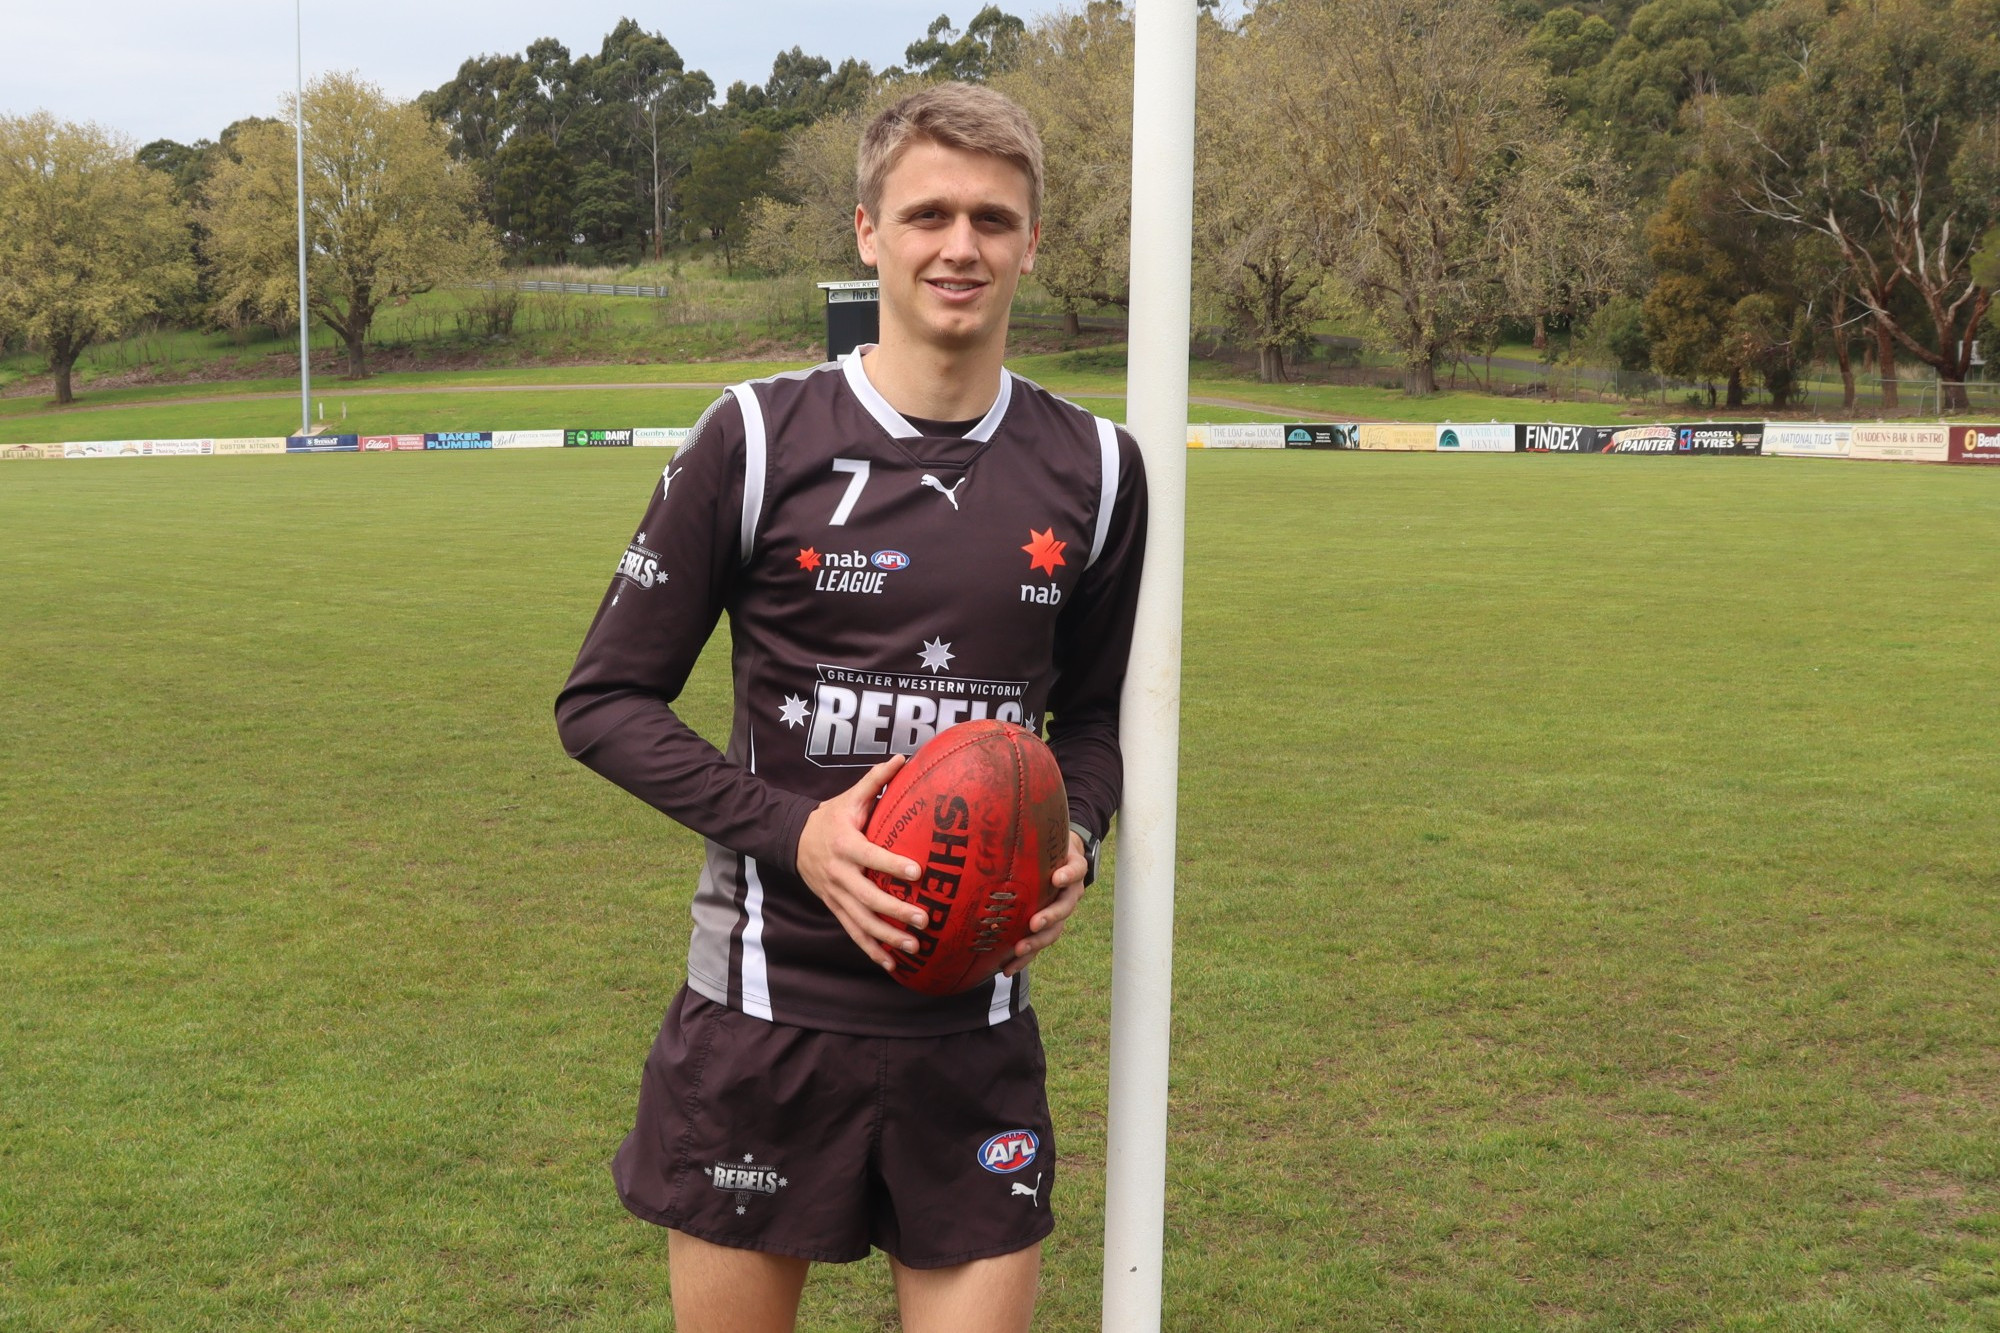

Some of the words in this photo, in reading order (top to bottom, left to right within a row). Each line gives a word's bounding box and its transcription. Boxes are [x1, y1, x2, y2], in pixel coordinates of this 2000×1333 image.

[852, 291, 867, 300] Five
[870, 290, 879, 300] St
[437, 432, 480, 441] BAKER
[634, 429, 666, 438] Country
[668, 428, 688, 437] Road
[1213, 428, 1227, 438] THE
[1256, 428, 1283, 438] LOUNGE
[1460, 427, 1492, 438] COUNTRY
[1525, 425, 1583, 451] FINDEX
[1694, 430, 1733, 438] COASTAL
[1780, 432, 1812, 445] NATIONAL
[1814, 433, 1833, 445] TILES
[1892, 432, 1908, 443] BAR
[1917, 433, 1944, 444] BISTRO
[365, 439, 390, 449] Elders
[426, 440, 492, 449] PLUMBING
[1471, 440, 1501, 450] DENTAL
[1621, 439, 1675, 452] PAINTER
[1692, 438, 1735, 448] TYRES
[828, 457, 871, 526] 7
[825, 550, 867, 568] nab
[875, 554, 906, 566] AFL
[815, 569, 888, 594] LEAGUE
[1020, 582, 1062, 606] nab
[827, 670, 892, 687] GREATER
[898, 677, 965, 694] WESTERN
[969, 683, 1022, 697] VICTORIA
[809, 685, 1022, 756] REBE
[985, 1136, 1036, 1166] AFL
[713, 1166, 778, 1194] REBELS
